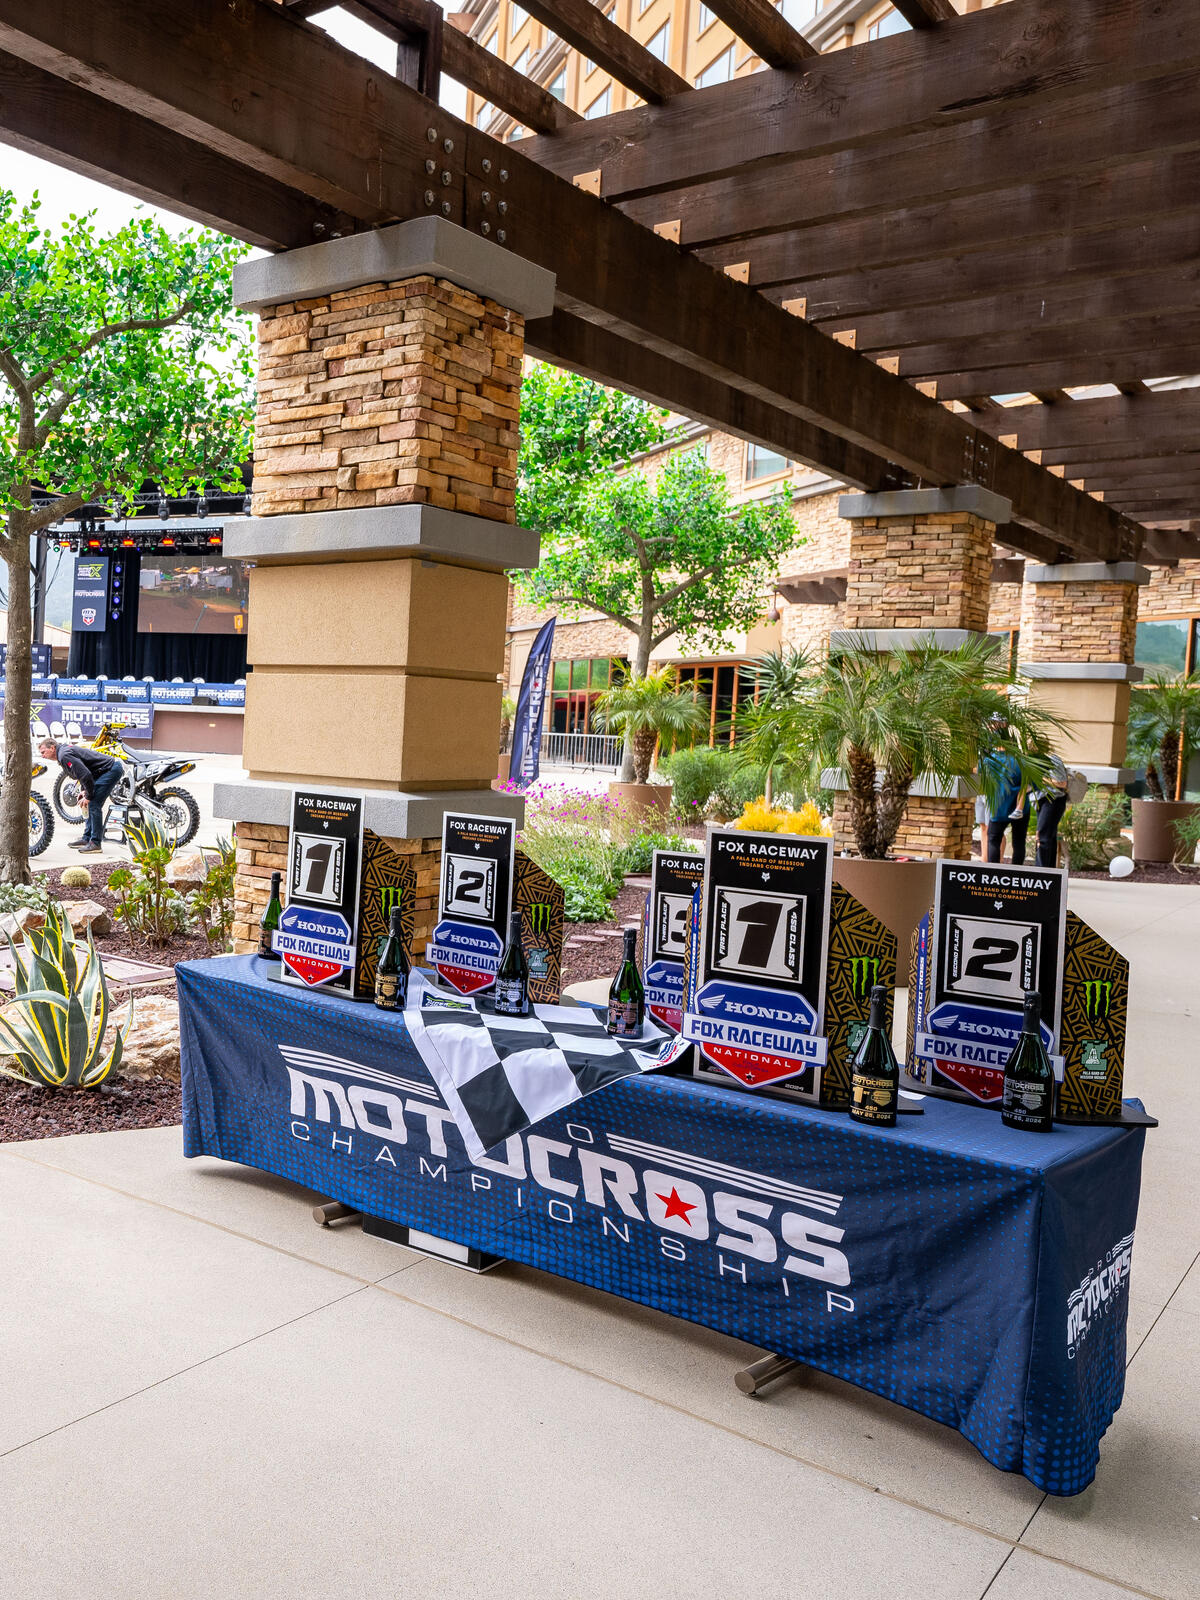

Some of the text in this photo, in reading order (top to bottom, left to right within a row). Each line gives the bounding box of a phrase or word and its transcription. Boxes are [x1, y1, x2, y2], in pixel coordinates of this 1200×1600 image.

[61, 710, 150, 723] MOTOCROSS
[298, 797, 357, 812] FOX RACEWAY
[450, 820, 508, 835] FOX RACEWAY
[718, 840, 819, 860] FOX RACEWAY
[305, 843, 333, 895] 1
[661, 859, 680, 869] FOX
[739, 861, 795, 872] INDIANS COMPANY
[777, 859, 805, 867] MISSION
[455, 870, 485, 904] 2
[949, 871, 1053, 890] FOX RACEWAY
[998, 893, 1028, 901] COMPANY
[1010, 889, 1039, 897] MISSION
[297, 920, 347, 938] HONDA
[719, 902, 728, 955] FIRST PLACE
[736, 901, 784, 969] 1
[277, 935, 350, 962] FOX RACEWAY
[449, 934, 500, 951] HONDA
[788, 911, 798, 967] 450 CLASS
[289, 956, 335, 971] NATIONAL
[431, 947, 450, 962] FOX
[964, 937, 1019, 982] 2
[1023, 938, 1033, 990] 450 CLASS
[443, 966, 488, 981] NATIONAL
[724, 1001, 811, 1026] HONDA
[691, 1019, 818, 1057] FOX RACEWAY
[713, 1046, 791, 1069] NATIONAL
[923, 1038, 1011, 1066] FOX RACE
[947, 1063, 1004, 1080] NATION
[1005, 1079, 1045, 1091] OTOCROSS
[286, 1065, 852, 1287] MOTOCROSS
[291, 1121, 855, 1313] CHAMPIONSHIP
[1088, 1250, 1112, 1277] PRO
